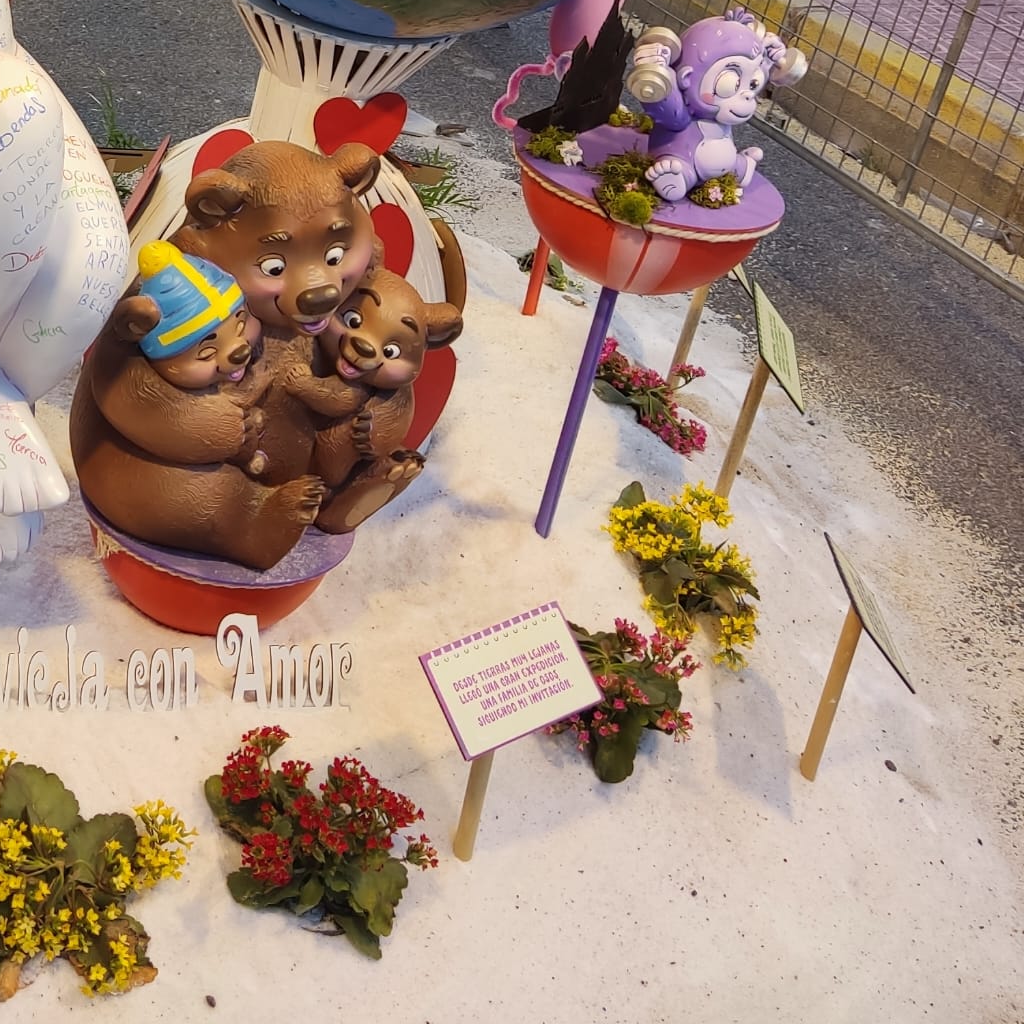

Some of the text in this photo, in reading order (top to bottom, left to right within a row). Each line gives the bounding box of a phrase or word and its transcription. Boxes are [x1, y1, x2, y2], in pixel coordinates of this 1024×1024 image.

[126, 647, 198, 711] con
[216, 613, 354, 712] Amor
[453, 640, 560, 692] DESDE TIERRAS MUY LEJANAS
[483, 680, 500, 694] UNA
[500, 671, 520, 686] GRAN
[521, 651, 568, 677] EXPEDICIÓN,
[478, 679, 573, 726] SIGUIENDO MI INVITACIÓN.
[480, 696, 497, 710] UNA
[498, 683, 528, 702] FAMILIA
[528, 678, 539, 689] DE
